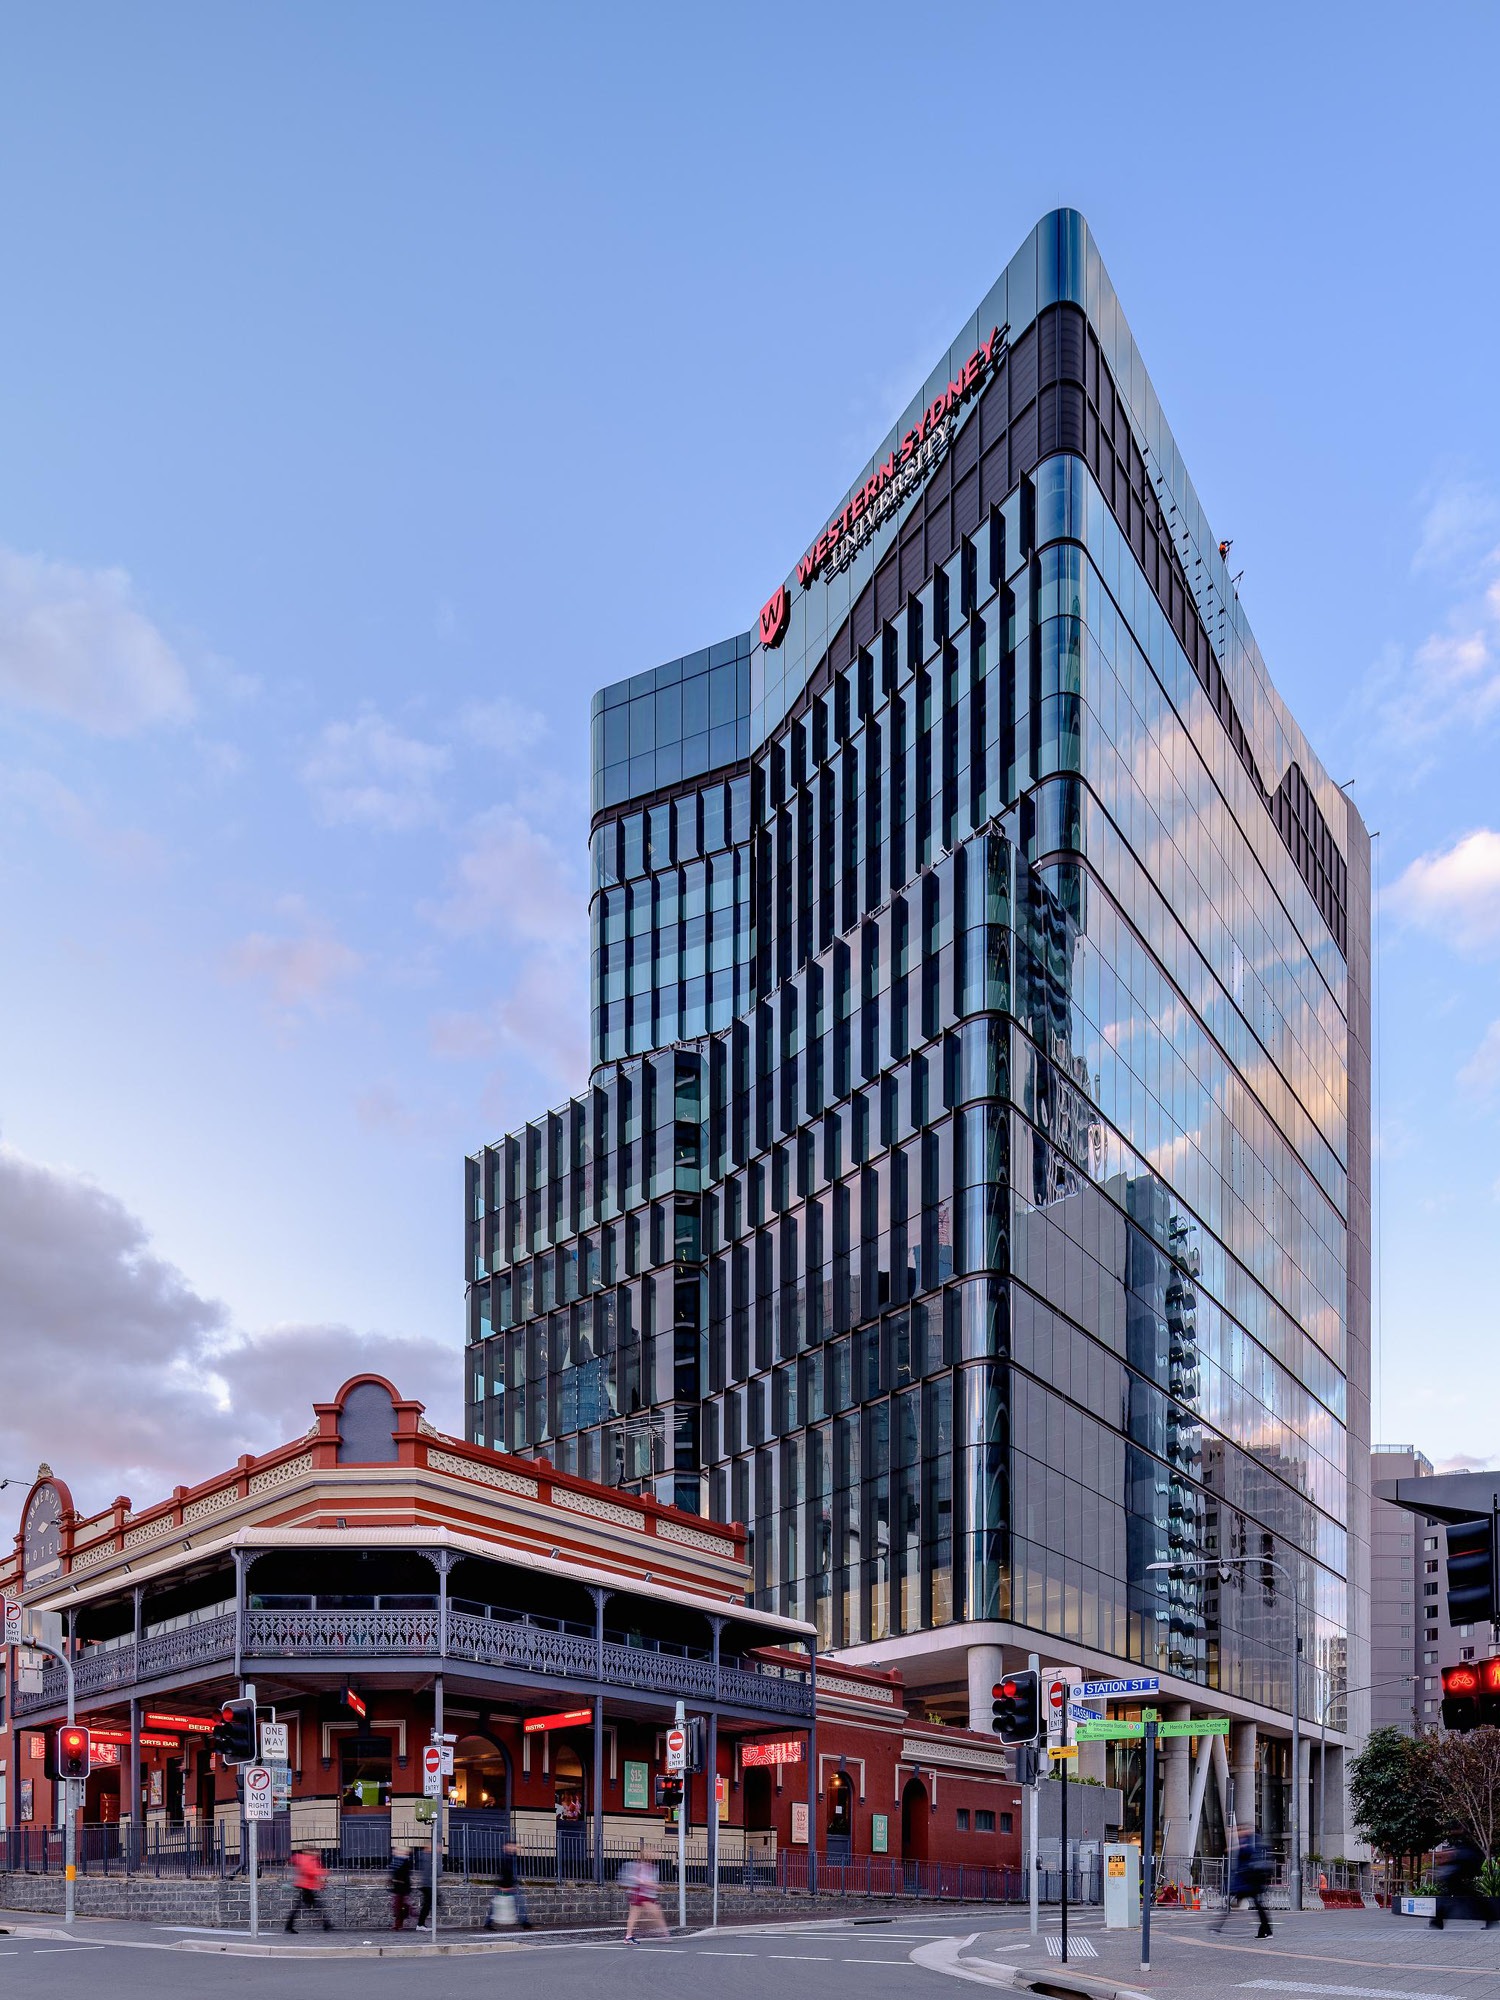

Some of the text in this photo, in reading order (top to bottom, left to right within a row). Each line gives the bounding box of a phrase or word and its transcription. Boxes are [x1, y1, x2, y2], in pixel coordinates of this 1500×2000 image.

[796, 325, 998, 586] WESTERN SYDNEY
[831, 417, 952, 568] UNIVERSITY
[26, 1490, 60, 1542] COMMERCIA
[25, 1539, 61, 1565] HOTEL
[1086, 1678, 1157, 1694] STATION ST E
[1053, 1709, 1063, 1718] NO
[188, 1723, 211, 1731] BEER
[265, 1727, 283, 1736] ONE
[525, 1723, 545, 1731] BISTRO
[264, 1738, 284, 1746] WAY
[428, 1775, 437, 1783] NO
[630, 1768, 643, 1783] $15
[425, 1784, 439, 1792] ENTRY
[251, 1792, 266, 1801] NO
